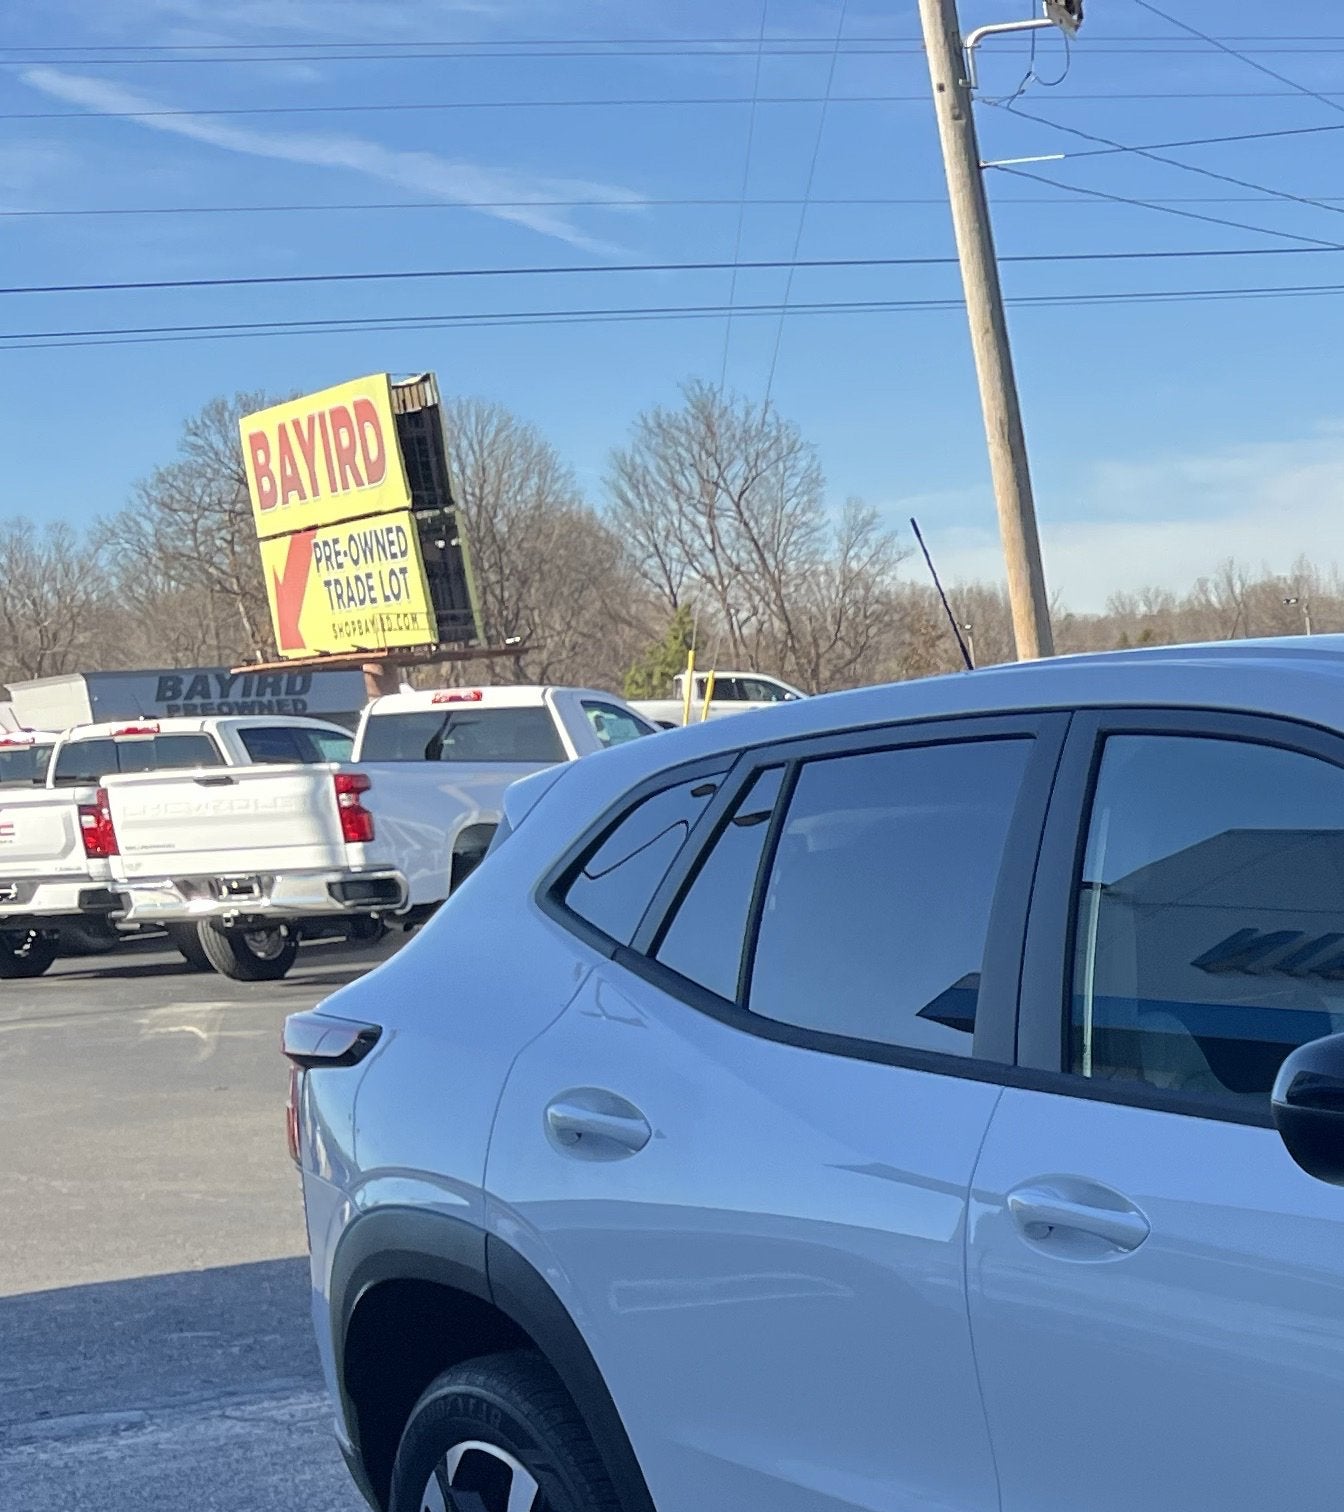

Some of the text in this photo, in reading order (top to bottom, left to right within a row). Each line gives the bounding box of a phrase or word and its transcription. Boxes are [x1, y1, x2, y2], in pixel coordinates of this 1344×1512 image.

[249, 398, 387, 511] BAYIRD
[313, 525, 408, 573] PRE-OWNED
[323, 566, 410, 611] TRADE LOT
[155, 673, 313, 702] BAYIRD
[166, 699, 309, 716] PREOWNED
